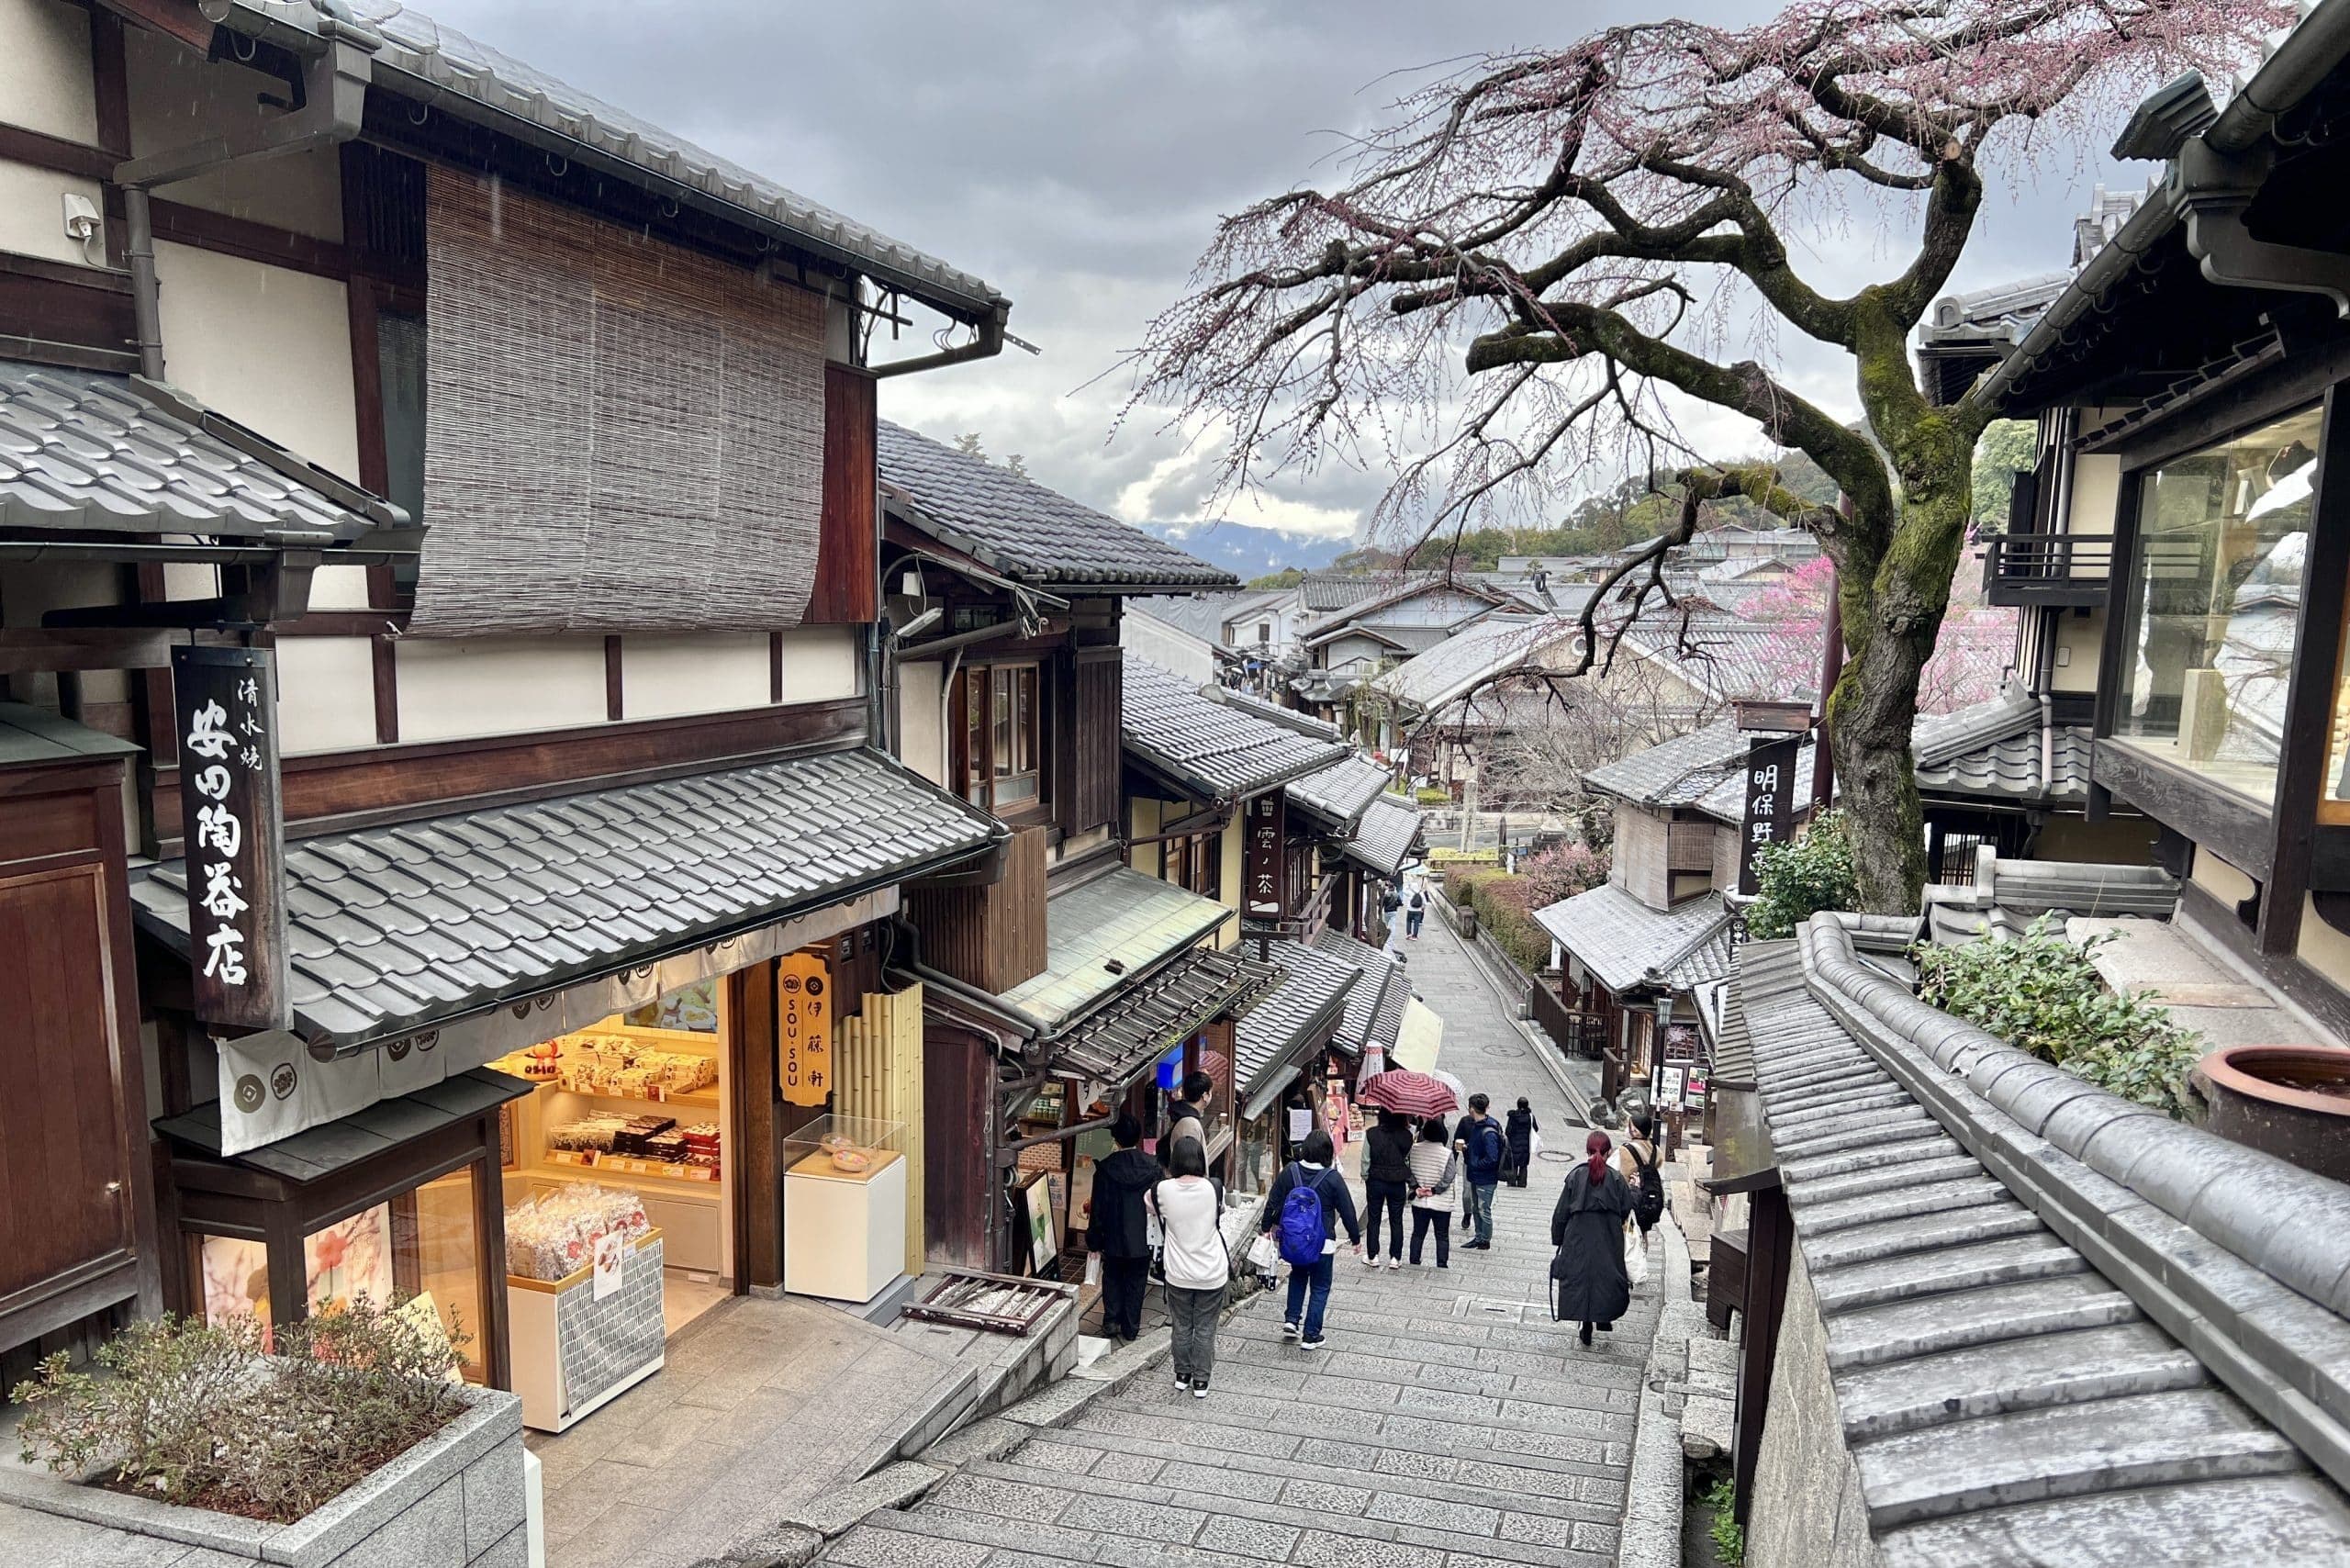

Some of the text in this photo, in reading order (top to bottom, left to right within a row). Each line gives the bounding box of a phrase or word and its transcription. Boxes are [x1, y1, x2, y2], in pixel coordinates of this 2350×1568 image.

[237, 677, 265, 771] 清水焼
[186, 698, 250, 986] 安田陶器店
[1257, 827, 1275, 894] 雲ノ茶
[807, 1001, 824, 1088] 伊藤軒
